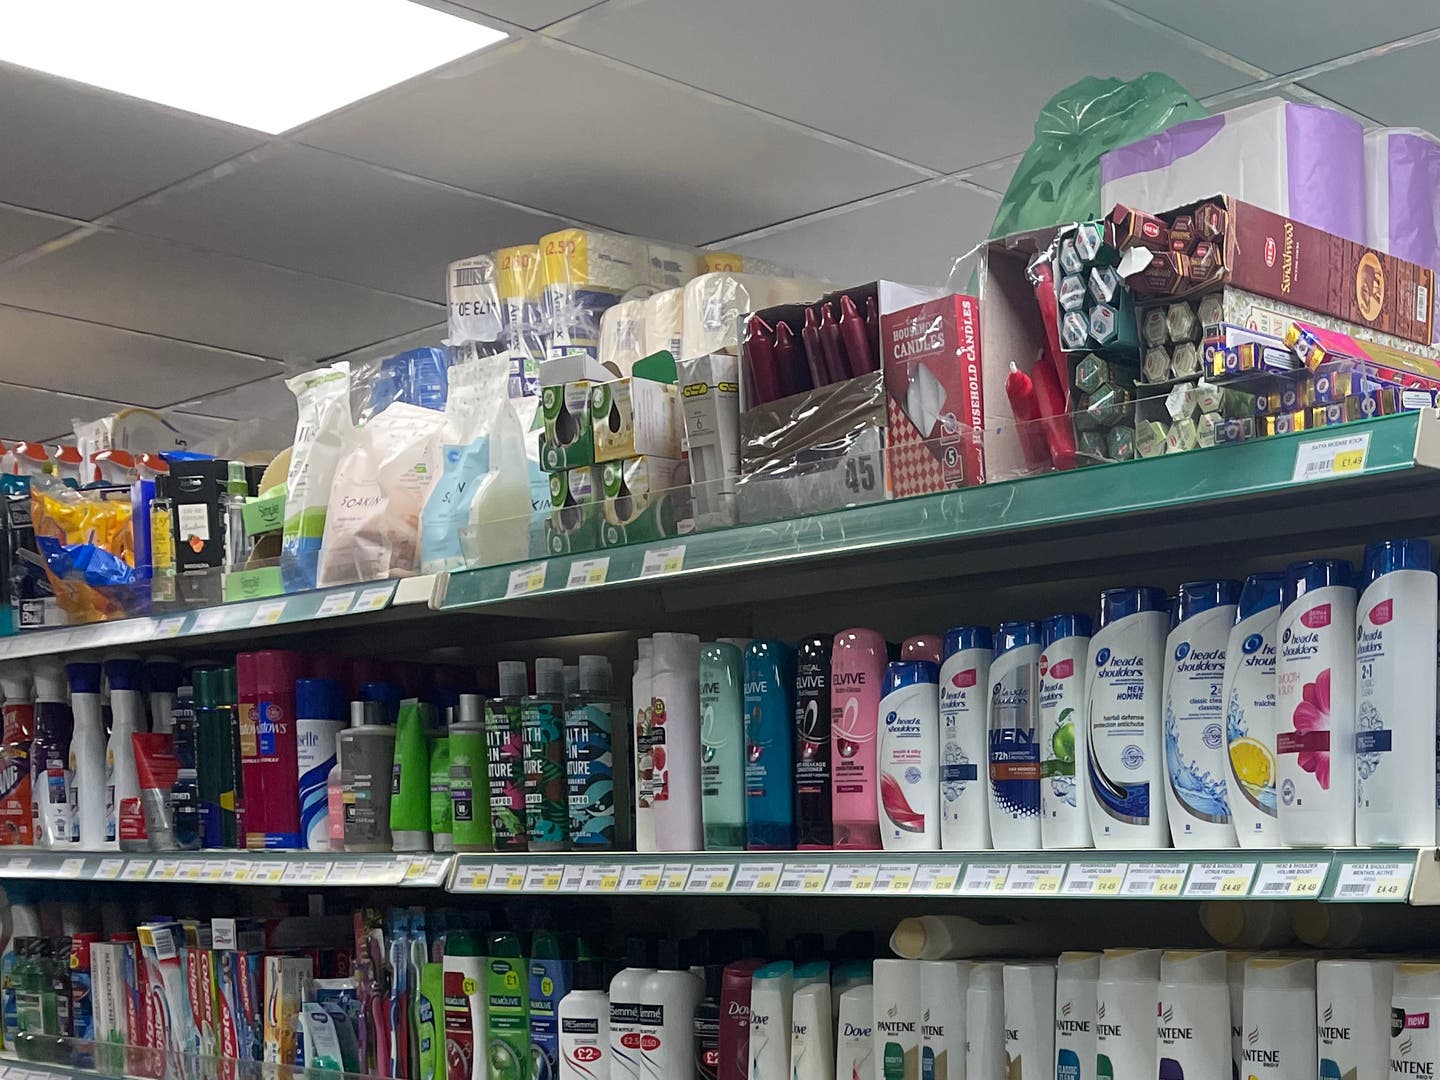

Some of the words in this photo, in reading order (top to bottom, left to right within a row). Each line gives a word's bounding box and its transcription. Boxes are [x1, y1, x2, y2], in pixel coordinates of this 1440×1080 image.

[1266, 240, 1275, 265] HEM
[1281, 222, 1294, 294] Sandalwood
[962, 300, 977, 361] CANDLES
[894, 335, 945, 359] CANDLES
[967, 365, 984, 444] HOUSEHOLD
[1342, 456, 1363, 467] £1.49
[845, 455, 876, 492] 45
[1282, 645, 1318, 657] shoulders
[1177, 660, 1225, 672] shoulders
[1098, 667, 1143, 678] shoulders
[796, 676, 825, 688] ELVIVE
[833, 673, 866, 685] ELVIVE
[989, 727, 1036, 744] MEN
[995, 752, 1009, 760] 72h
[1222, 883, 1242, 891] £4.49
[1297, 884, 1316, 892] £4.49
[1377, 886, 1398, 894] £4.49
[190, 952, 199, 1015] Colgate
[239, 956, 251, 1011] Colgate
[506, 975, 517, 985] £1
[201, 952, 212, 1022] Colgate
[464, 981, 476, 992] £1
[877, 1021, 916, 1033] PANTENE
[1407, 1016, 1426, 1026] new
[844, 1023, 872, 1037] Dove
